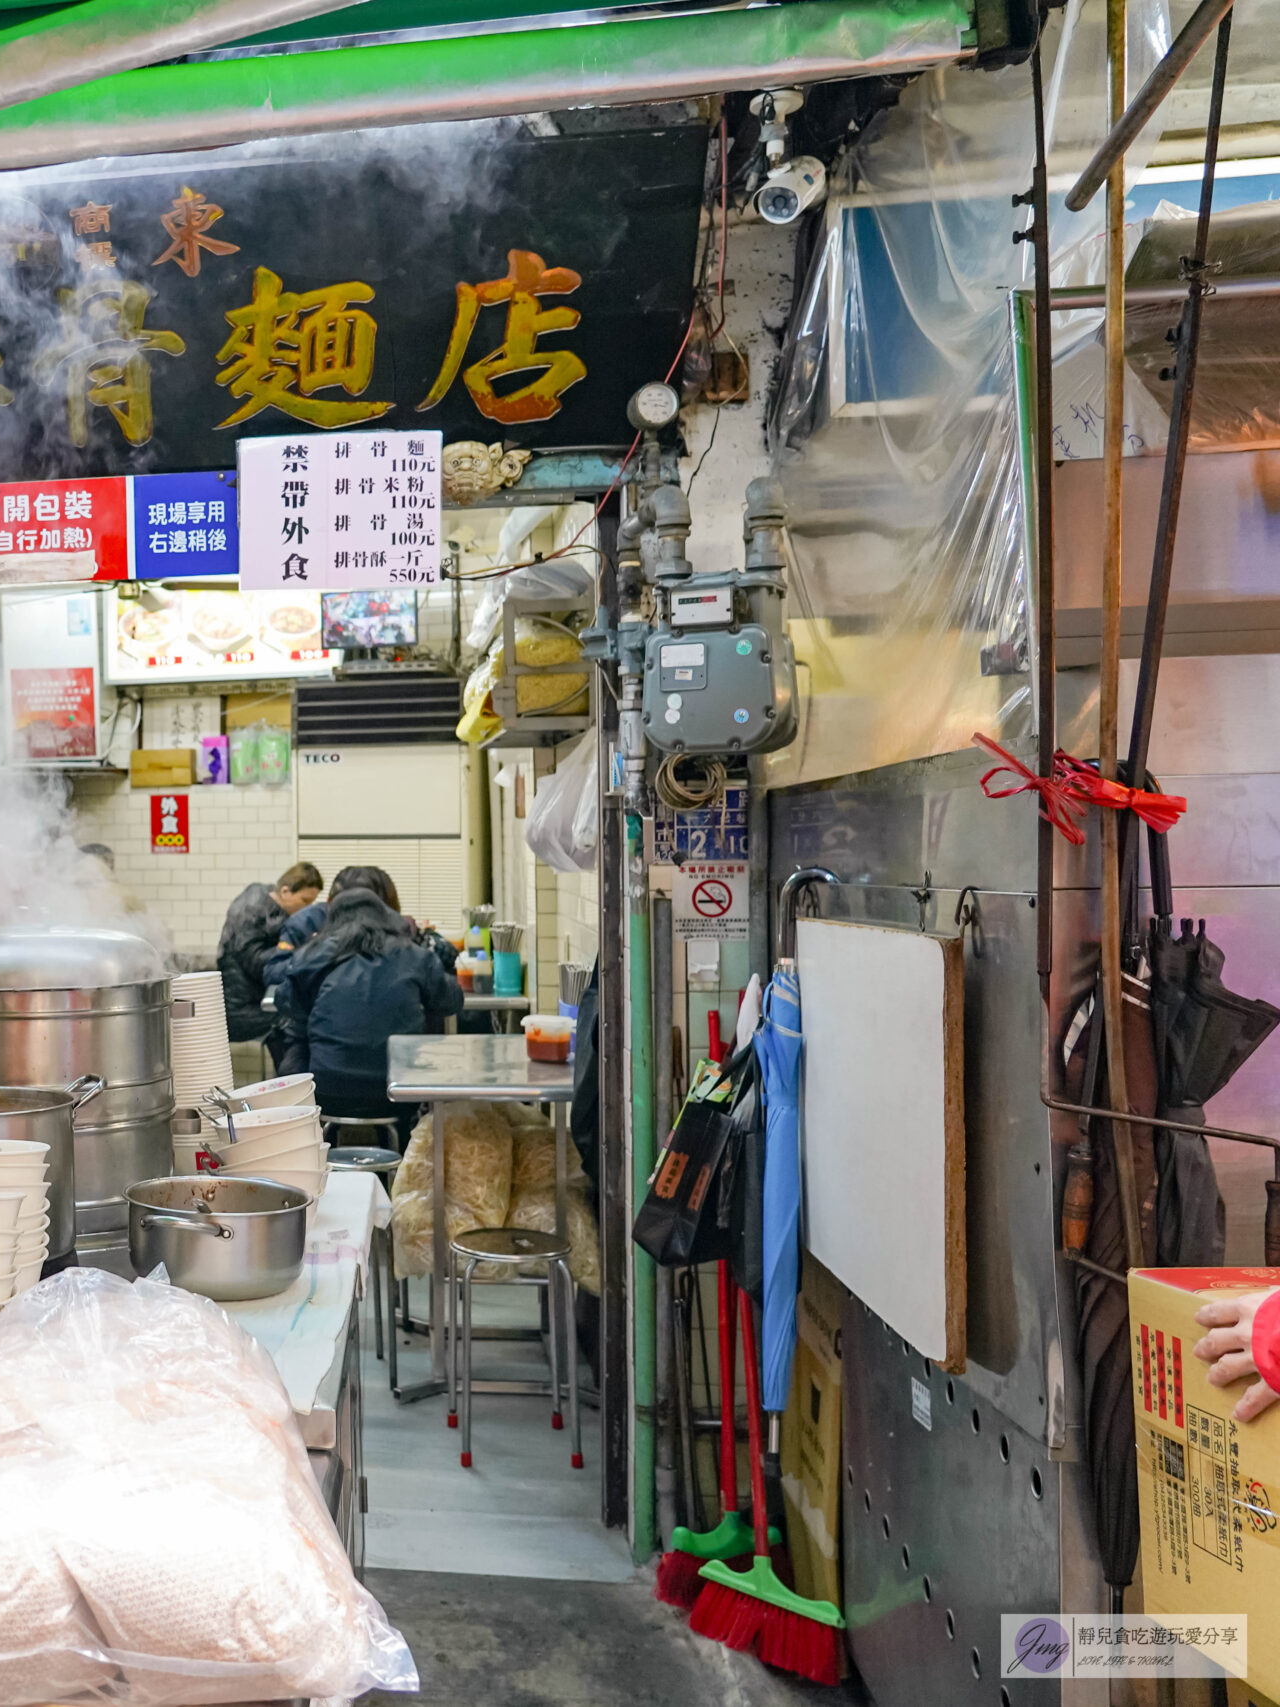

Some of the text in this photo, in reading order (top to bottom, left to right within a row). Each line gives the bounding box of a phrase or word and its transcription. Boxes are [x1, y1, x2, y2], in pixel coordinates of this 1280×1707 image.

[334, 439, 436, 473] 排骨麵 110元
[334, 475, 436, 509] 排骨米粉 110元
[148, 500, 226, 527] 現場享用
[281, 444, 310, 582] 禁帶外食
[334, 512, 435, 546] 排骨湯 100元
[148, 529, 227, 554] 右邊稍後
[334, 549, 435, 583] 排骨酥一斤 550元
[304, 753, 341, 764] TECO
[1212, 1421, 1224, 1456] 品名
[1228, 1419, 1245, 1573] 永豐抽取式柔紙巾
